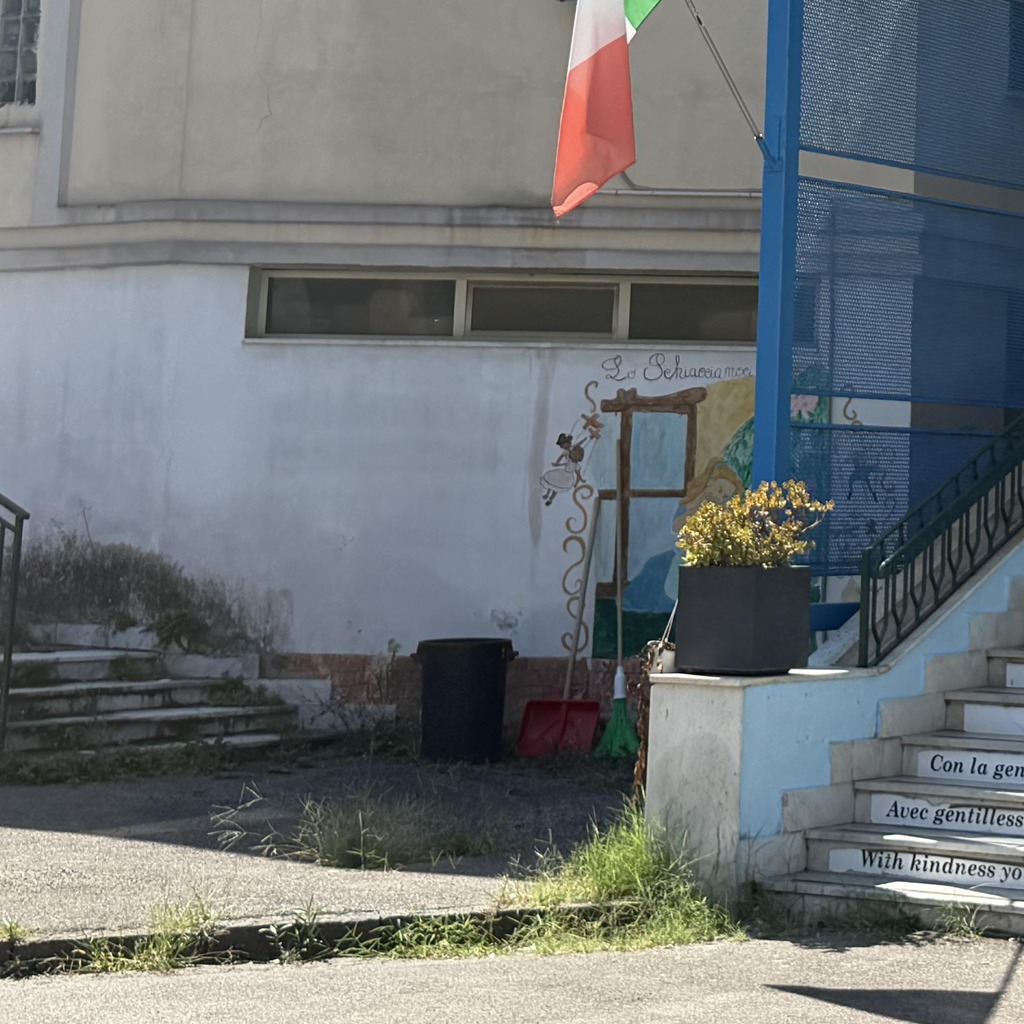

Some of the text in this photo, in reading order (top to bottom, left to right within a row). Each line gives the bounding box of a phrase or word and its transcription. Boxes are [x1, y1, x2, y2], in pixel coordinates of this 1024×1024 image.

[930, 754, 964, 773] Con
[969, 756, 988, 776] la
[886, 800, 929, 820] Avec
[860, 849, 904, 872] With
[910, 852, 996, 878] kindness
